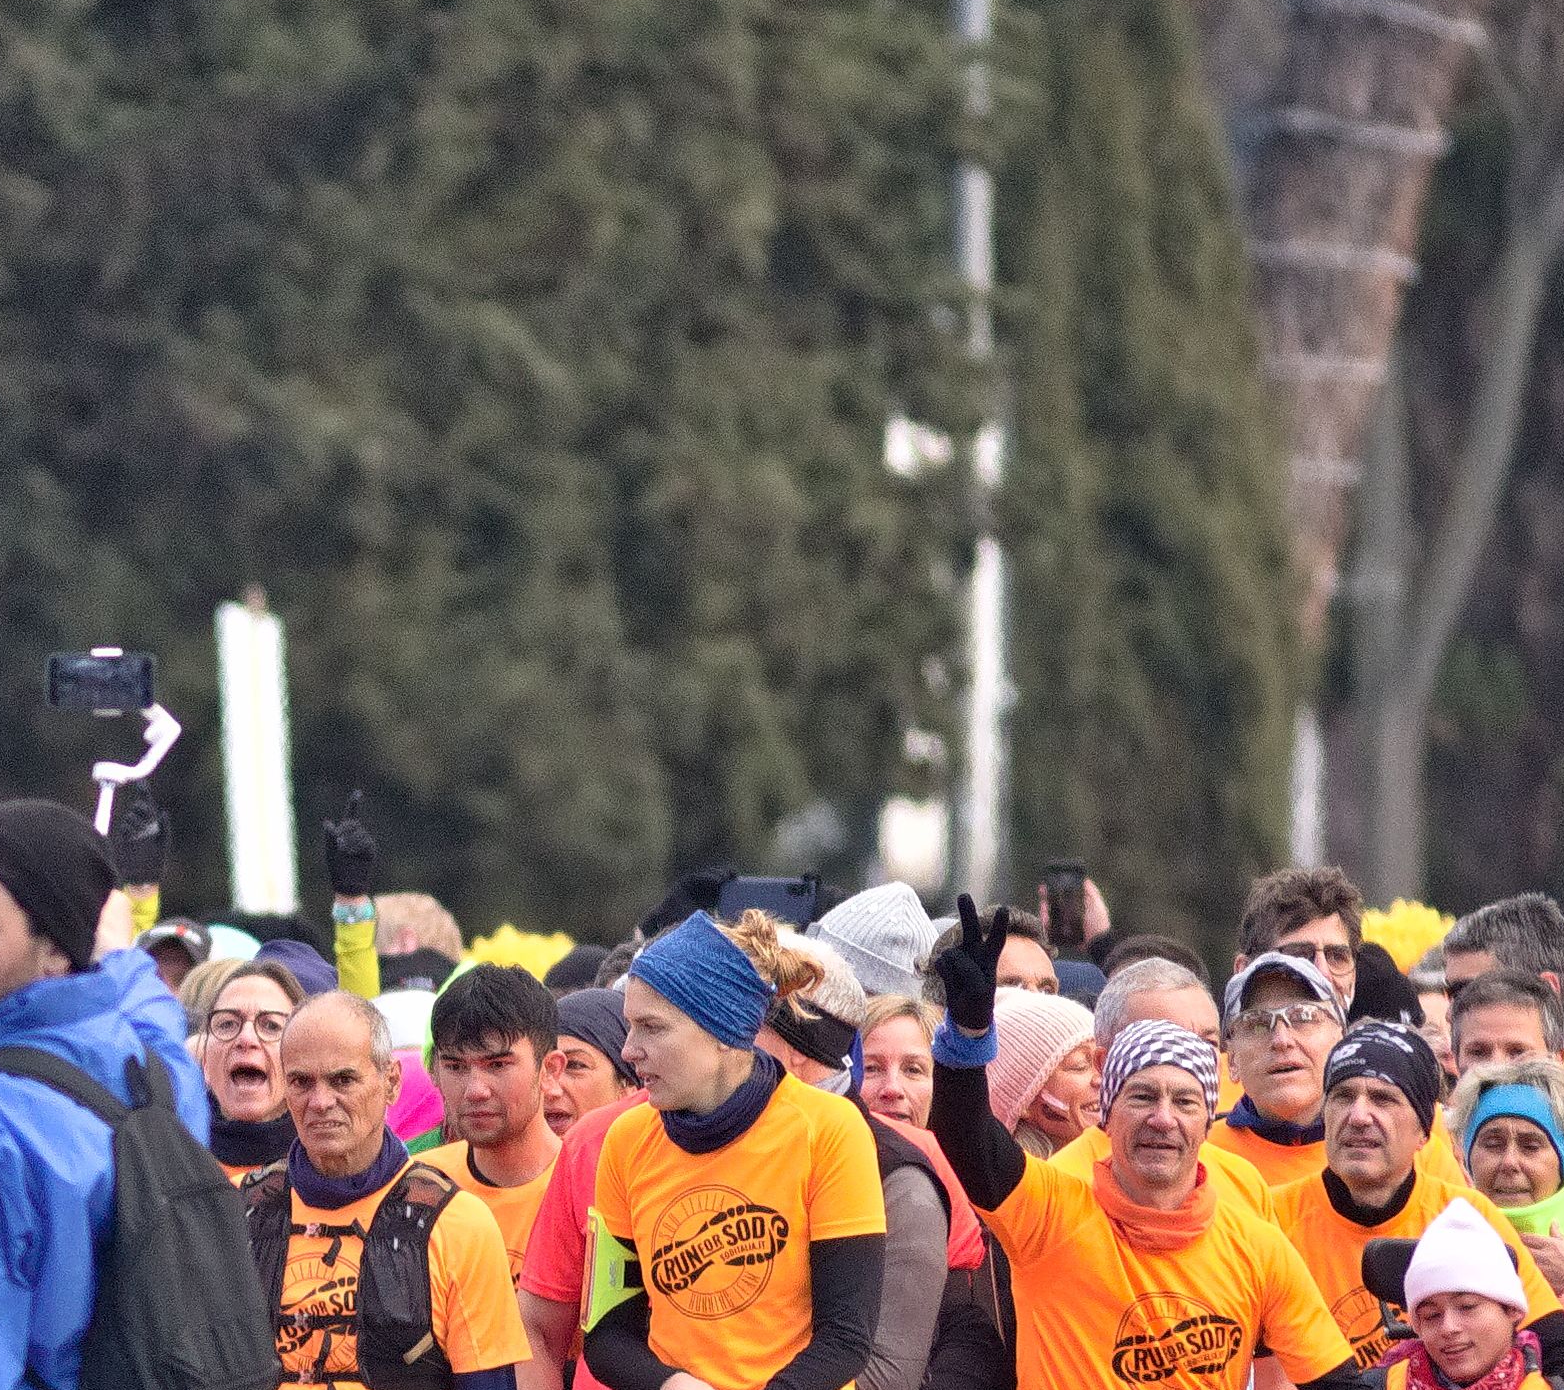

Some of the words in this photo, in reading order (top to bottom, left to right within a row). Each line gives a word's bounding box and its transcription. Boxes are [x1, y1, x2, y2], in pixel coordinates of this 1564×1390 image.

[663, 1244, 704, 1281] RUN
[698, 1233, 725, 1259] FOR
[722, 1216, 766, 1247] SOD
[1185, 1327, 1226, 1355] SOD
